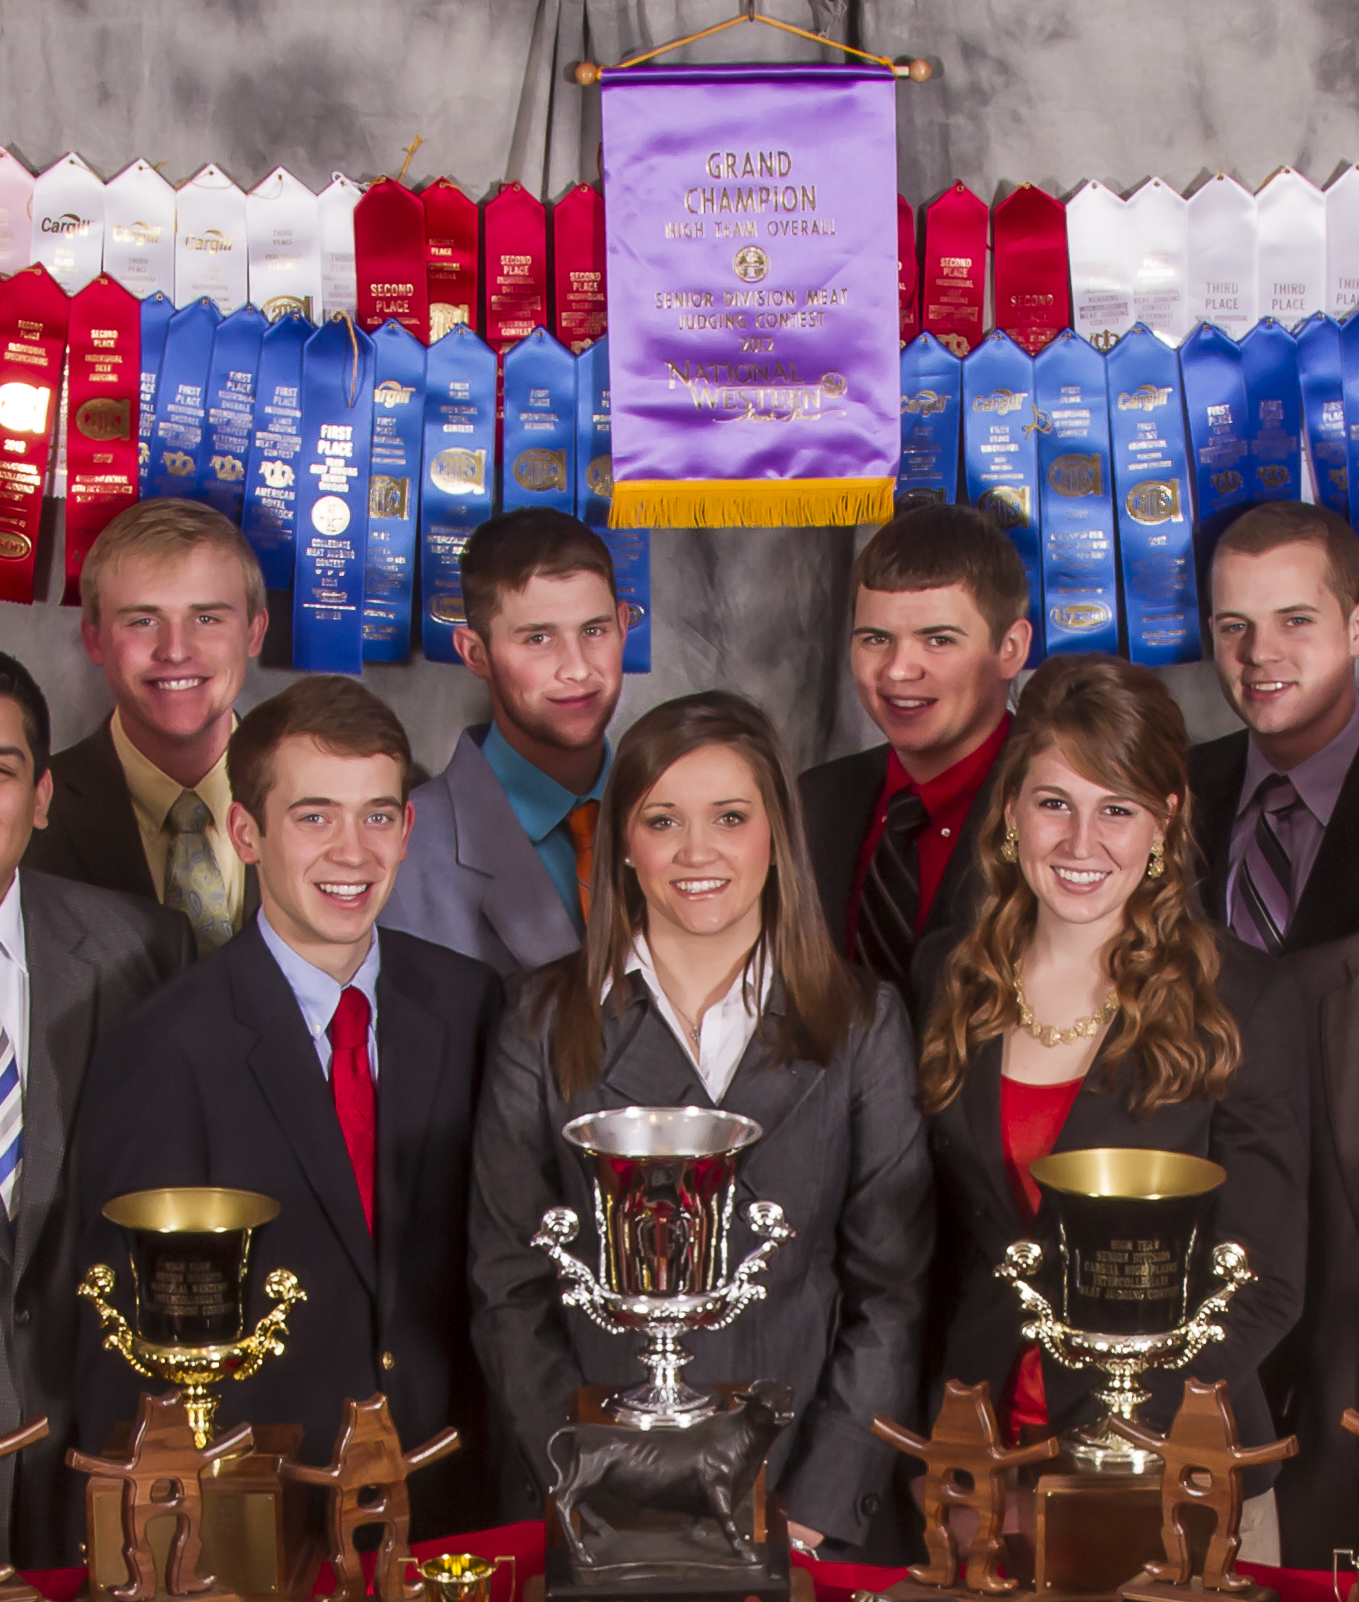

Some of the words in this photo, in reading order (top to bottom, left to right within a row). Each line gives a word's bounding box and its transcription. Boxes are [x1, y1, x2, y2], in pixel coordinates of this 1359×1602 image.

[707, 151, 792, 177] GRAND
[684, 186, 817, 214] CHAMPION
[41, 214, 90, 237] Cargill
[665, 221, 704, 238] HIGH
[715, 221, 758, 237] TEAM
[768, 219, 837, 236] OVERALL
[185, 230, 234, 253] Cargill
[371, 283, 413, 298] SECOND
[1206, 282, 1238, 295] THIRD
[1273, 283, 1305, 295] THIRD
[376, 298, 410, 313] PLACE
[655, 292, 714, 308] SENIOR
[724, 290, 796, 307] DIVISION
[807, 288, 848, 305] MEAT
[1206, 298, 1238, 310] PLACE
[1272, 299, 1305, 310] PLACE
[678, 312, 746, 330] JUDGING
[756, 311, 826, 328] CONTEST
[739, 336, 773, 353] 2012
[664, 361, 805, 388] NATIONAL
[691, 387, 821, 410] WESTERN
[321, 425, 353, 440] FIRST
[318, 440, 353, 457] PLACE
